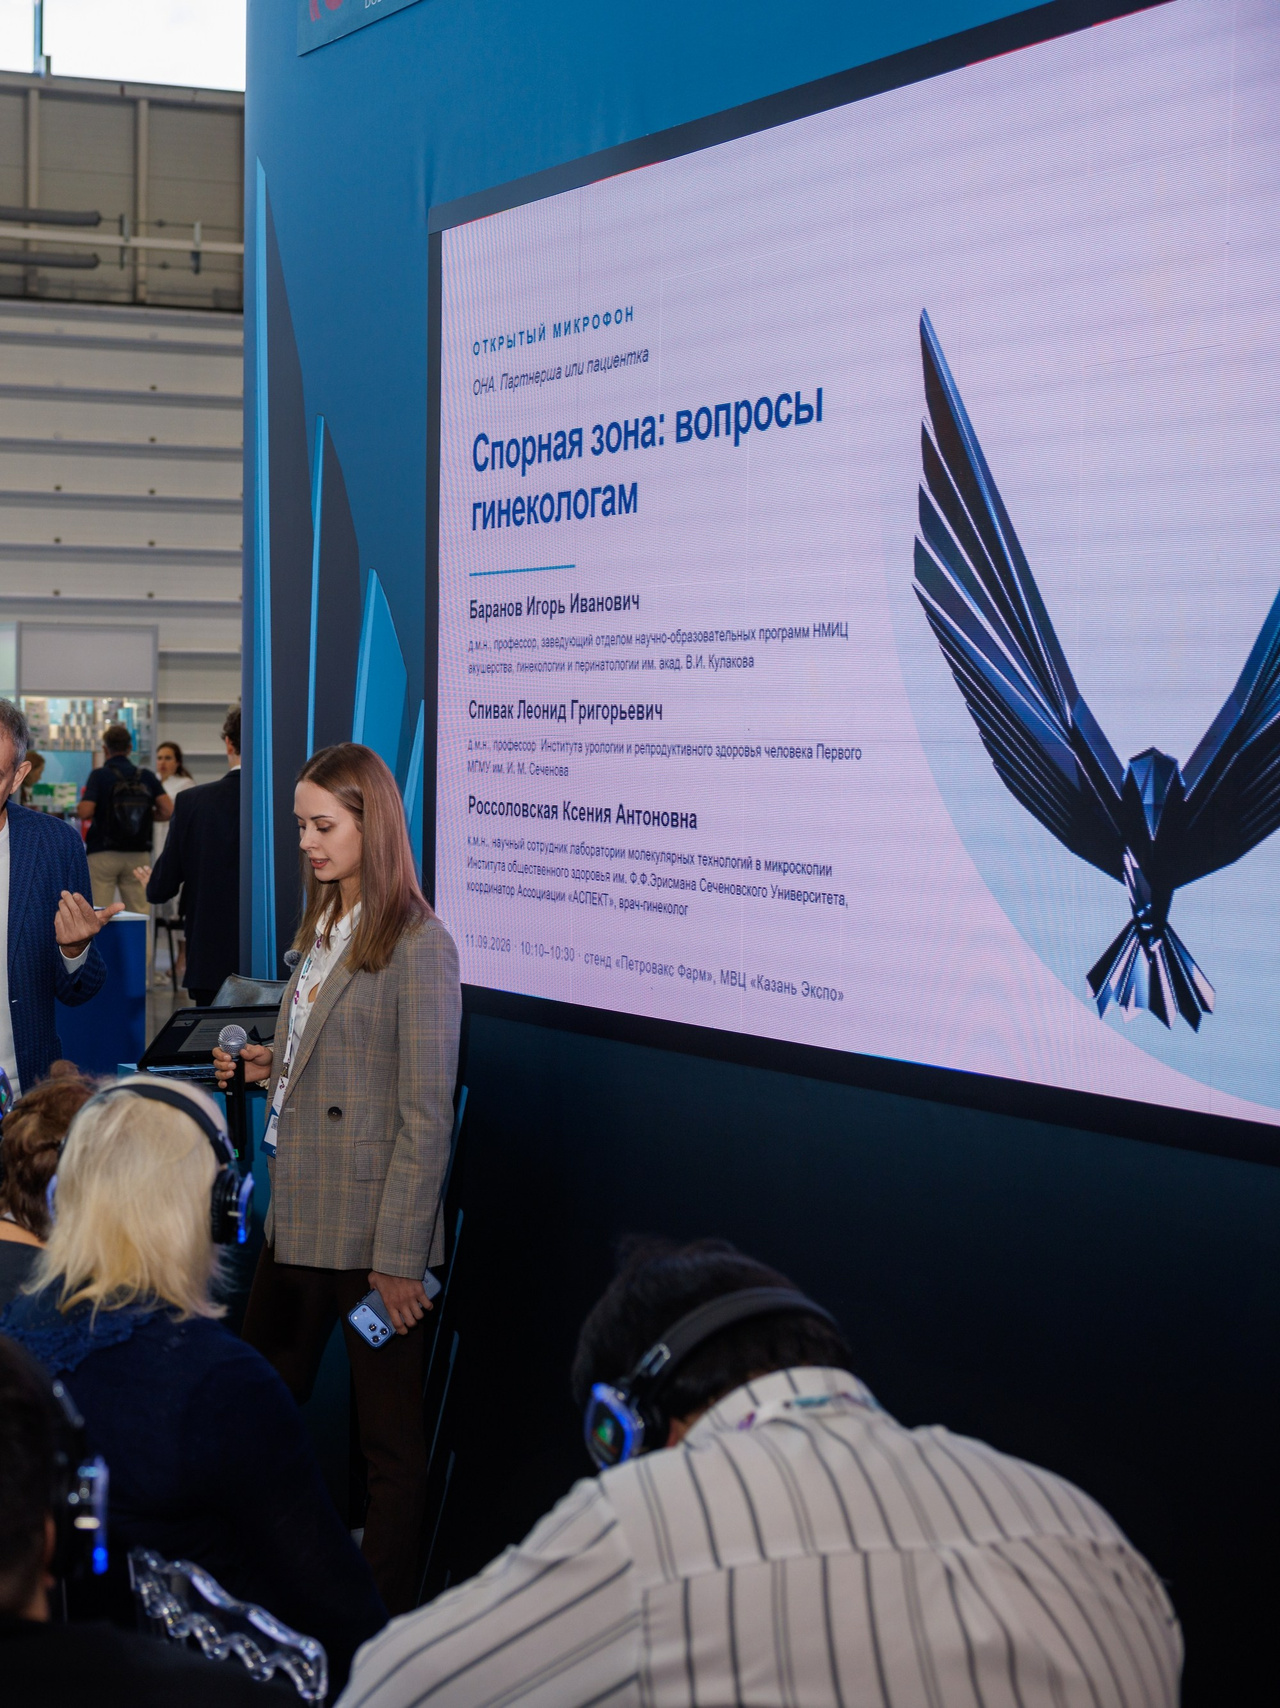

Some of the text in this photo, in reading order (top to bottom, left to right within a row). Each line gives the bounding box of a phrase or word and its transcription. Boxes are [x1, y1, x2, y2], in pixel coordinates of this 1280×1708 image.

[472, 306, 634, 356] ОТКРЫТЫЙ МИКРОФОН
[472, 348, 650, 396] ОНА. Партнерша или пациентка
[472, 387, 823, 477] Спорная зона: вопросы
[471, 482, 638, 531] гинекологам
[469, 593, 640, 623] Баранов Игорь Иванович
[541, 634, 593, 651] заведующий
[595, 632, 633, 647] отделом
[635, 628, 756, 648] научно-образовательных
[759, 625, 810, 643] программ
[813, 621, 849, 641] НМИЦ
[516, 660, 565, 673] гинекологии
[575, 658, 639, 674] перинатологии
[642, 659, 656, 671] им.
[659, 657, 683, 671] акад.
[686, 654, 706, 670] В.И.
[708, 653, 755, 672] Кулакова
[469, 699, 663, 725] Спивак Леонид Григорьевич
[467, 760, 492, 774] МГМУ
[506, 761, 516, 775] И.
[517, 761, 527, 775] М.
[529, 761, 569, 777] Сеченова
[540, 738, 583, 756] Института
[585, 741, 624, 756] урологии
[634, 742, 713, 759] репродуктивного
[715, 745, 761, 760] здоровья
[764, 745, 813, 759] человека
[816, 742, 862, 763] Первого
[468, 795, 697, 830] Россоловская Ксения Антоновна
[492, 838, 525, 854] научный
[526, 840, 568, 857] сотрудник
[569, 841, 626, 860] лаборатории
[628, 849, 695, 867] молекулярных
[697, 853, 753, 871] технологий
[755, 859, 762, 871] в
[764, 860, 833, 878] микроскопии
[466, 880, 689, 917] координатор Ассоциации «АСПЕКТ», врач-гинеколог
[467, 856, 849, 909] Института общественного здоровья им. Ф.Ф.Эрисмана Сеченовского Университета,
[465, 933, 511, 953] 11.09.2026
[584, 953, 612, 969] стенд
[615, 955, 675, 978] «Петровакс
[677, 964, 716, 986] Фарм»,
[720, 969, 746, 991] МВЦ
[750, 974, 798, 996] «Казань
[801, 980, 844, 1002] Экспо»
